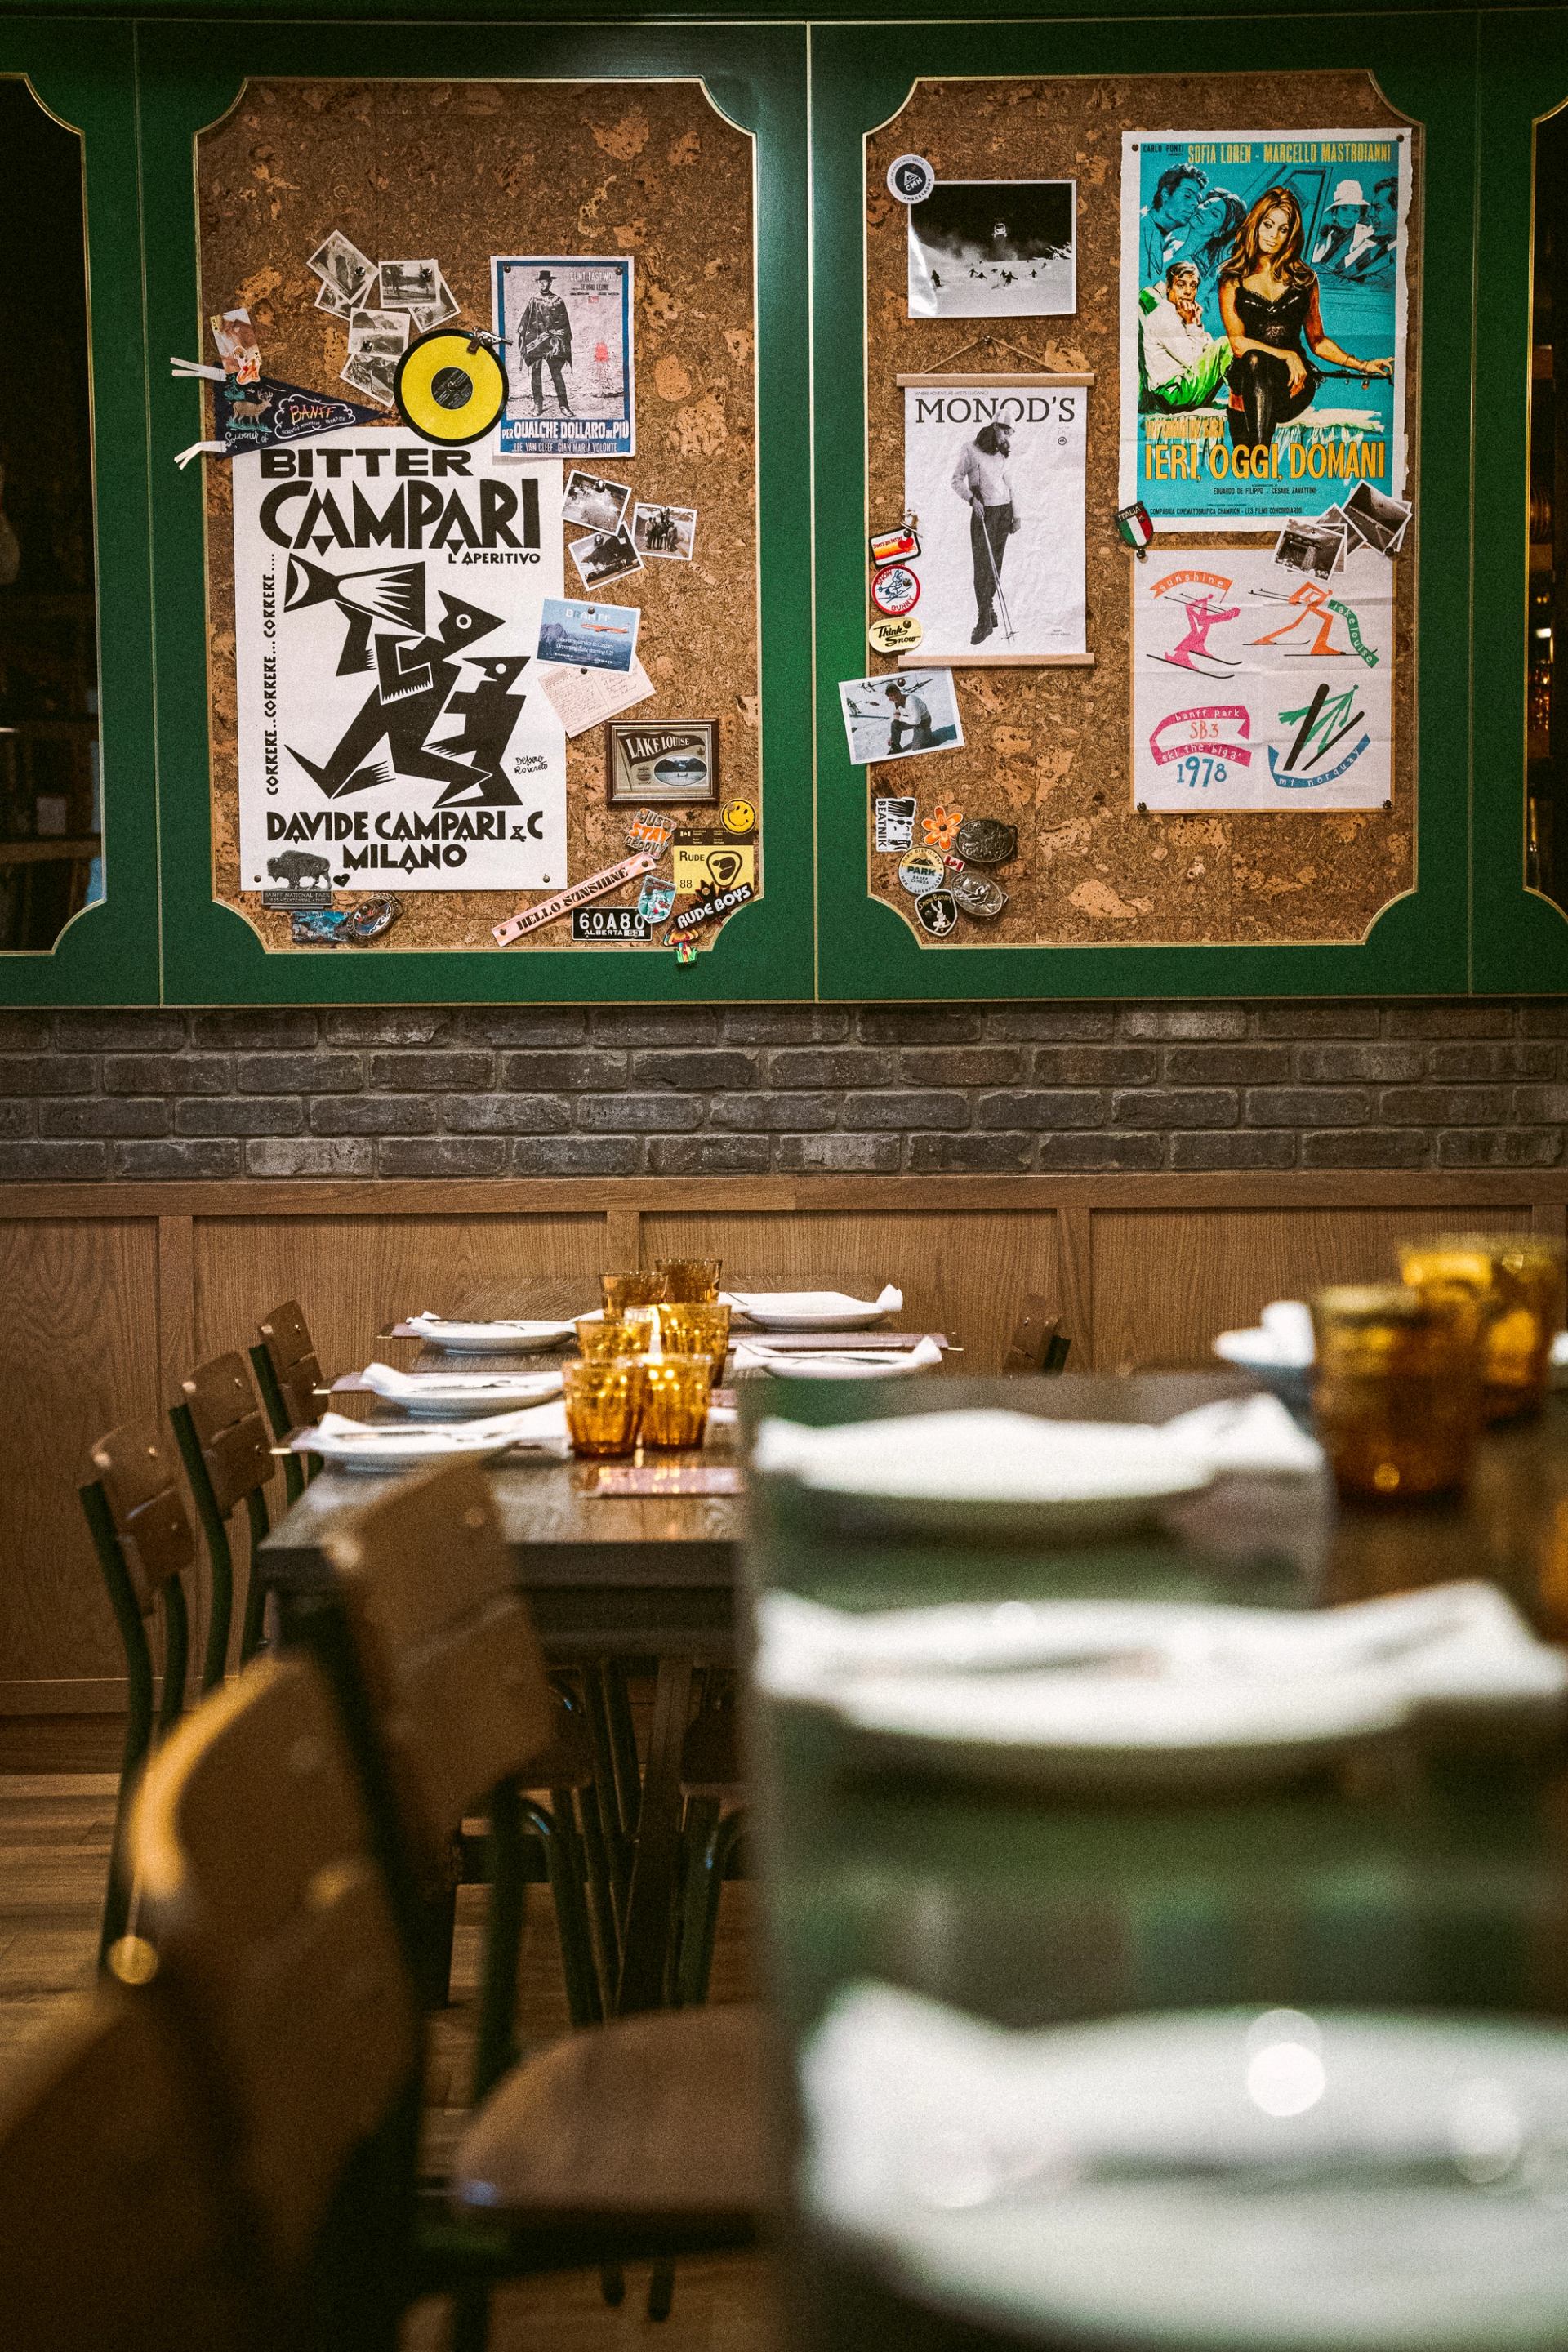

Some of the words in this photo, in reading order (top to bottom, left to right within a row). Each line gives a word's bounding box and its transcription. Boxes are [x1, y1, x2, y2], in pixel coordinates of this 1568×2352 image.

[1143, 144, 1162, 153] CARLO
[1188, 144, 1216, 163] SOFIA
[1221, 143, 1252, 163] LOREN
[1263, 143, 1317, 163] MARCELLO
[1321, 143, 1391, 163] MASTROIANNI
[903, 178, 932, 201] AMBASSADOR
[906, 176, 923, 191] CMH
[570, 271, 586, 282] CLINT
[289, 404, 336, 425] BANFF
[915, 396, 1075, 424] MONOD'S
[225, 430, 260, 448] Souvenir
[261, 433, 270, 443] of
[502, 429, 514, 439] PER
[514, 421, 558, 439] QUALCHE
[560, 420, 605, 439] DOLLARO
[514, 442, 523, 452] LEE
[525, 442, 537, 452] VAN
[538, 442, 554, 452] CLEEF
[557, 442, 571, 452] GIAN
[572, 442, 591, 452] MARIA
[261, 448, 473, 478] BITTER
[1145, 443, 1201, 483] IERI,
[1209, 443, 1282, 483] OGGI,
[1290, 441, 1385, 479] DOMANI
[260, 478, 541, 556] CAMPARI
[1117, 504, 1142, 521] ITALIA
[876, 569, 893, 586] SNOW
[1159, 572, 1224, 591] sunshine
[891, 595, 915, 611] BUNNY
[873, 624, 908, 638] Think
[1333, 602, 1356, 624] lake
[1350, 626, 1373, 662] louise
[884, 635, 921, 647] Snow
[1175, 709, 1207, 722] banff
[1214, 708, 1240, 718] park
[626, 737, 662, 759] LAKE
[661, 736, 690, 751] LOUISE
[1162, 749, 1178, 763] ski
[1184, 744, 1204, 753] the
[1177, 755, 1227, 788] 1978
[1279, 778, 1295, 787] mt
[1307, 748, 1361, 786] norquay
[267, 811, 368, 844] DAVIDE
[375, 811, 506, 843] CAMPARI
[510, 826, 527, 842] &
[527, 811, 543, 840] C
[630, 823, 673, 844] STAY
[877, 800, 887, 848] BEATNIK
[625, 835, 669, 857] GROOVY
[343, 844, 467, 875] MILANO
[907, 866, 936, 876] PARK
[679, 880, 693, 889] 88
[516, 902, 562, 931] HELLO
[562, 866, 629, 907] SUNSHINE
[677, 902, 714, 930] RUDE
[714, 884, 751, 912] BOYS
[918, 898, 933, 911] Snow
[933, 893, 951, 903] Bunny
[579, 912, 645, 930] 60A80
